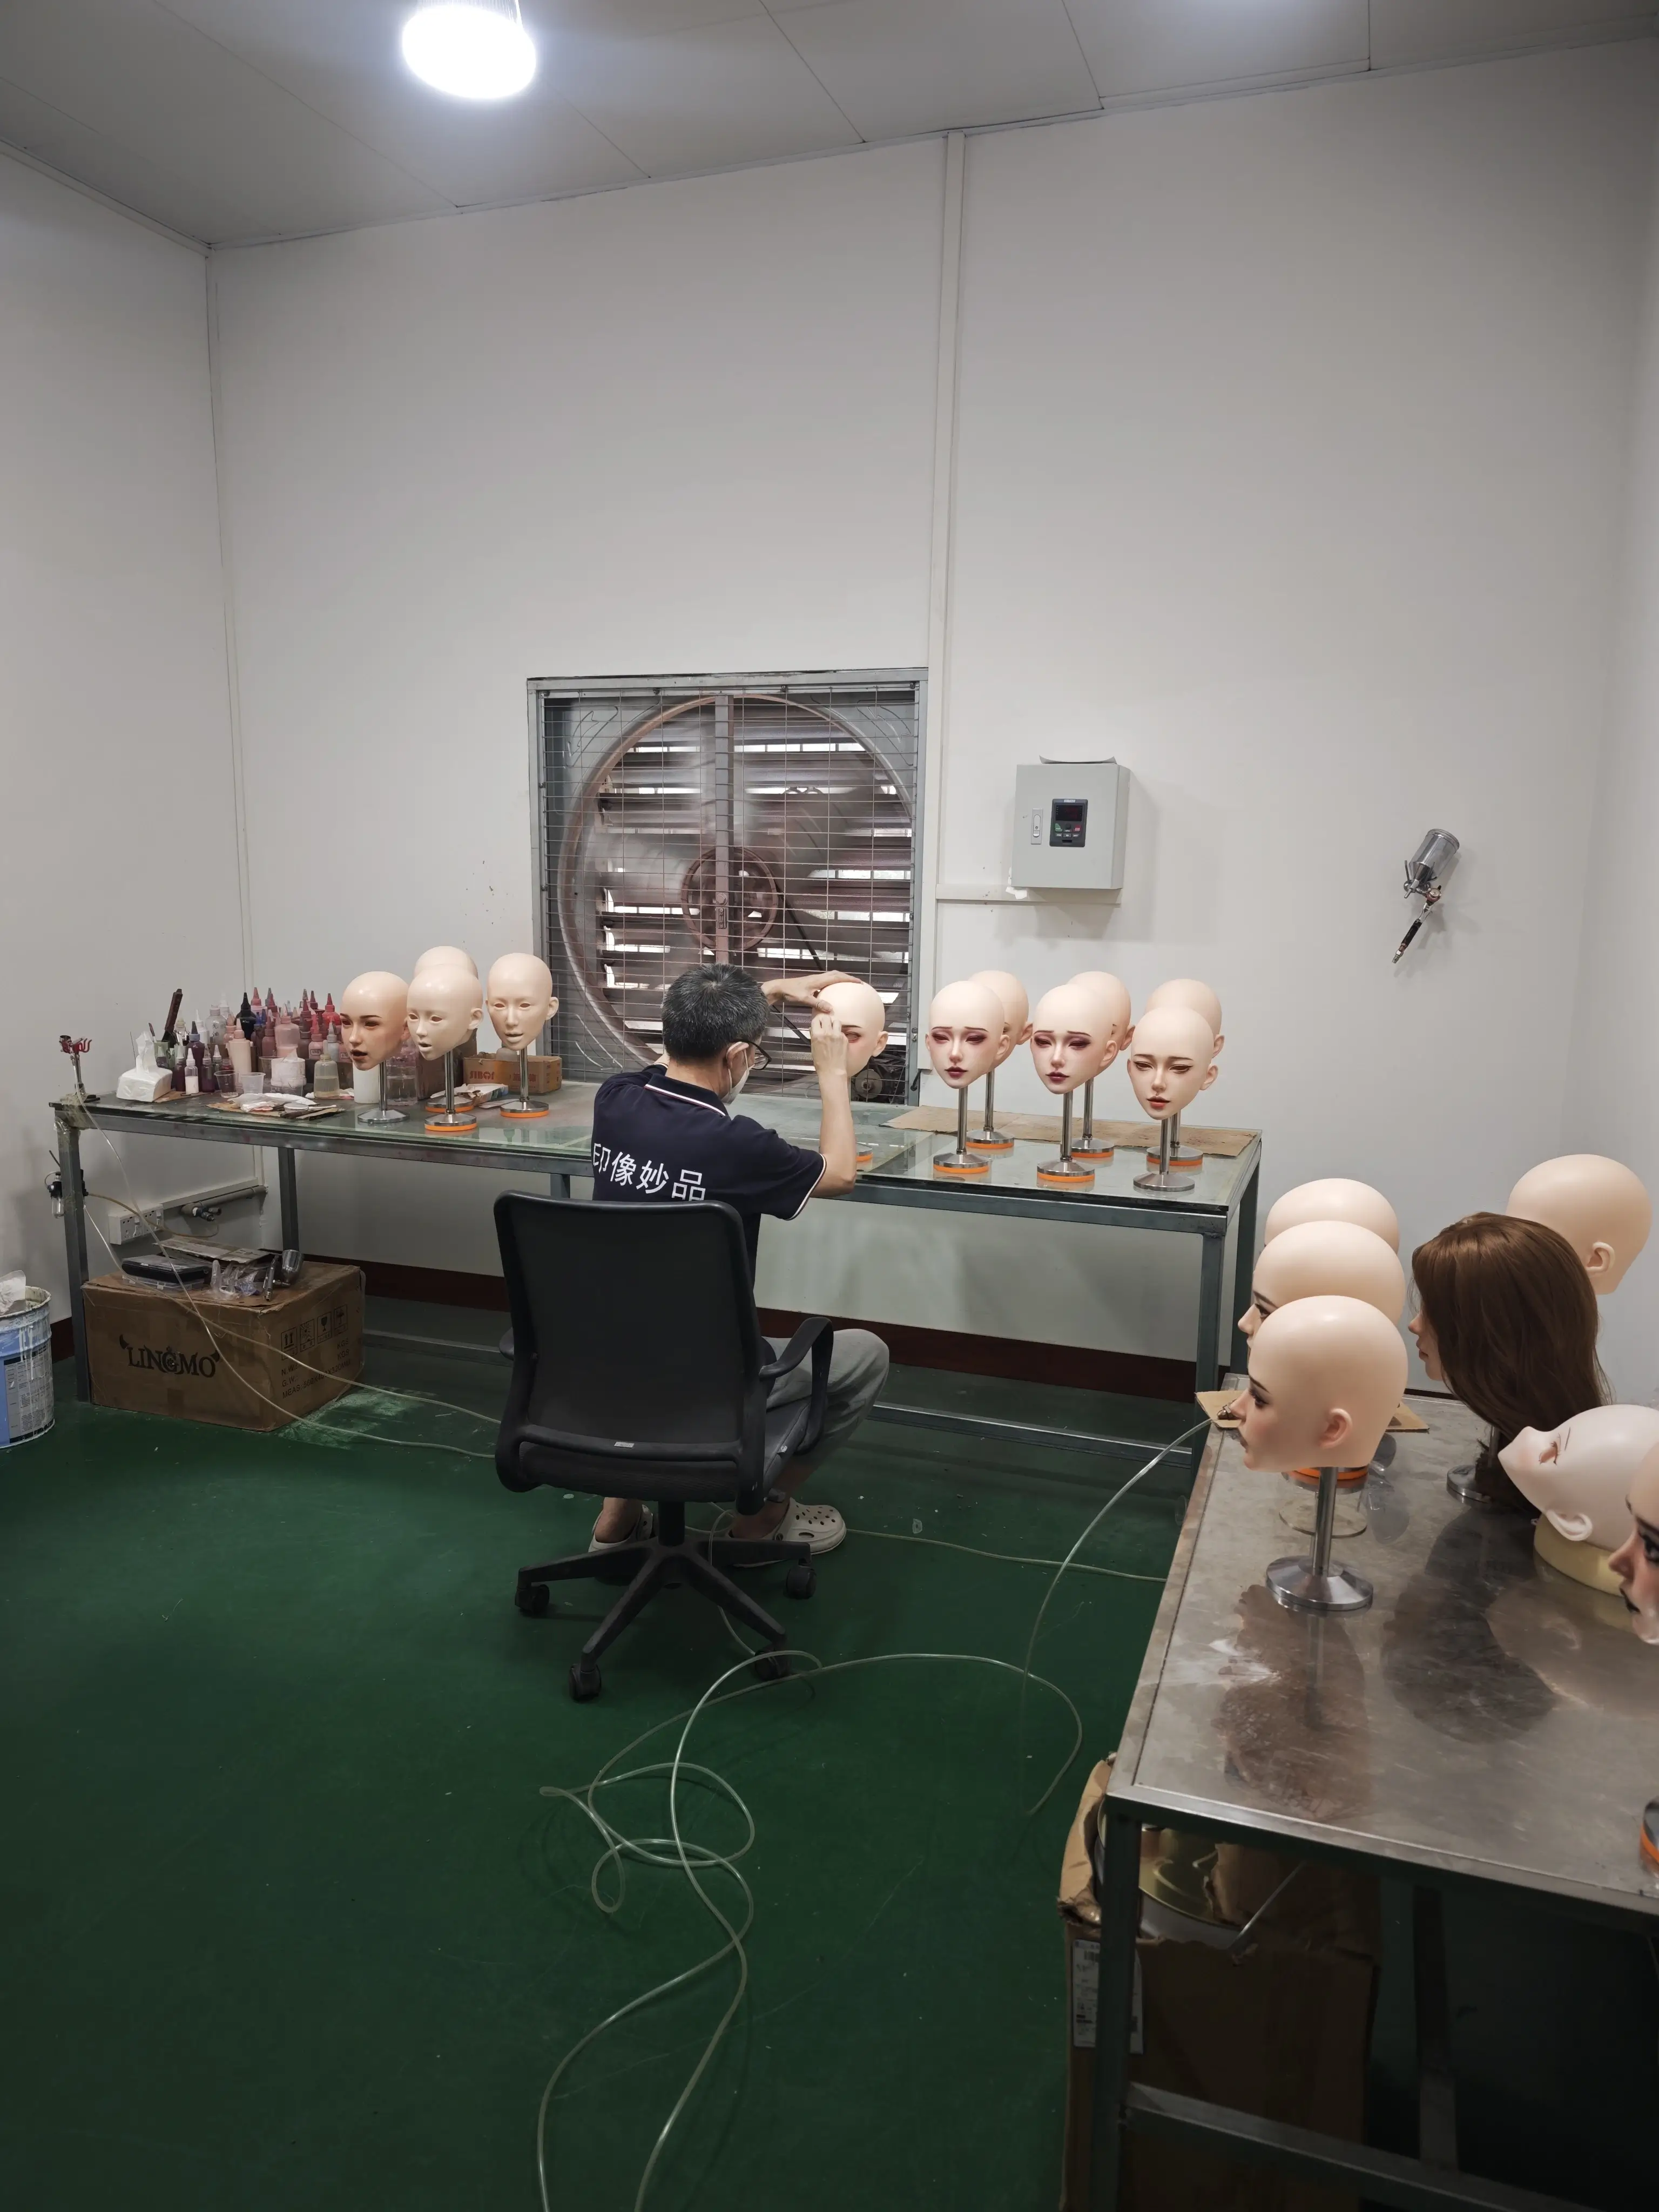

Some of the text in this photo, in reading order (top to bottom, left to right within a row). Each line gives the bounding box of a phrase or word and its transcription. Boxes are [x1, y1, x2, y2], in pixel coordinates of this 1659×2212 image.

[592, 1142, 706, 1201] 印像妙品
[126, 1344, 216, 1378] LINGMO
